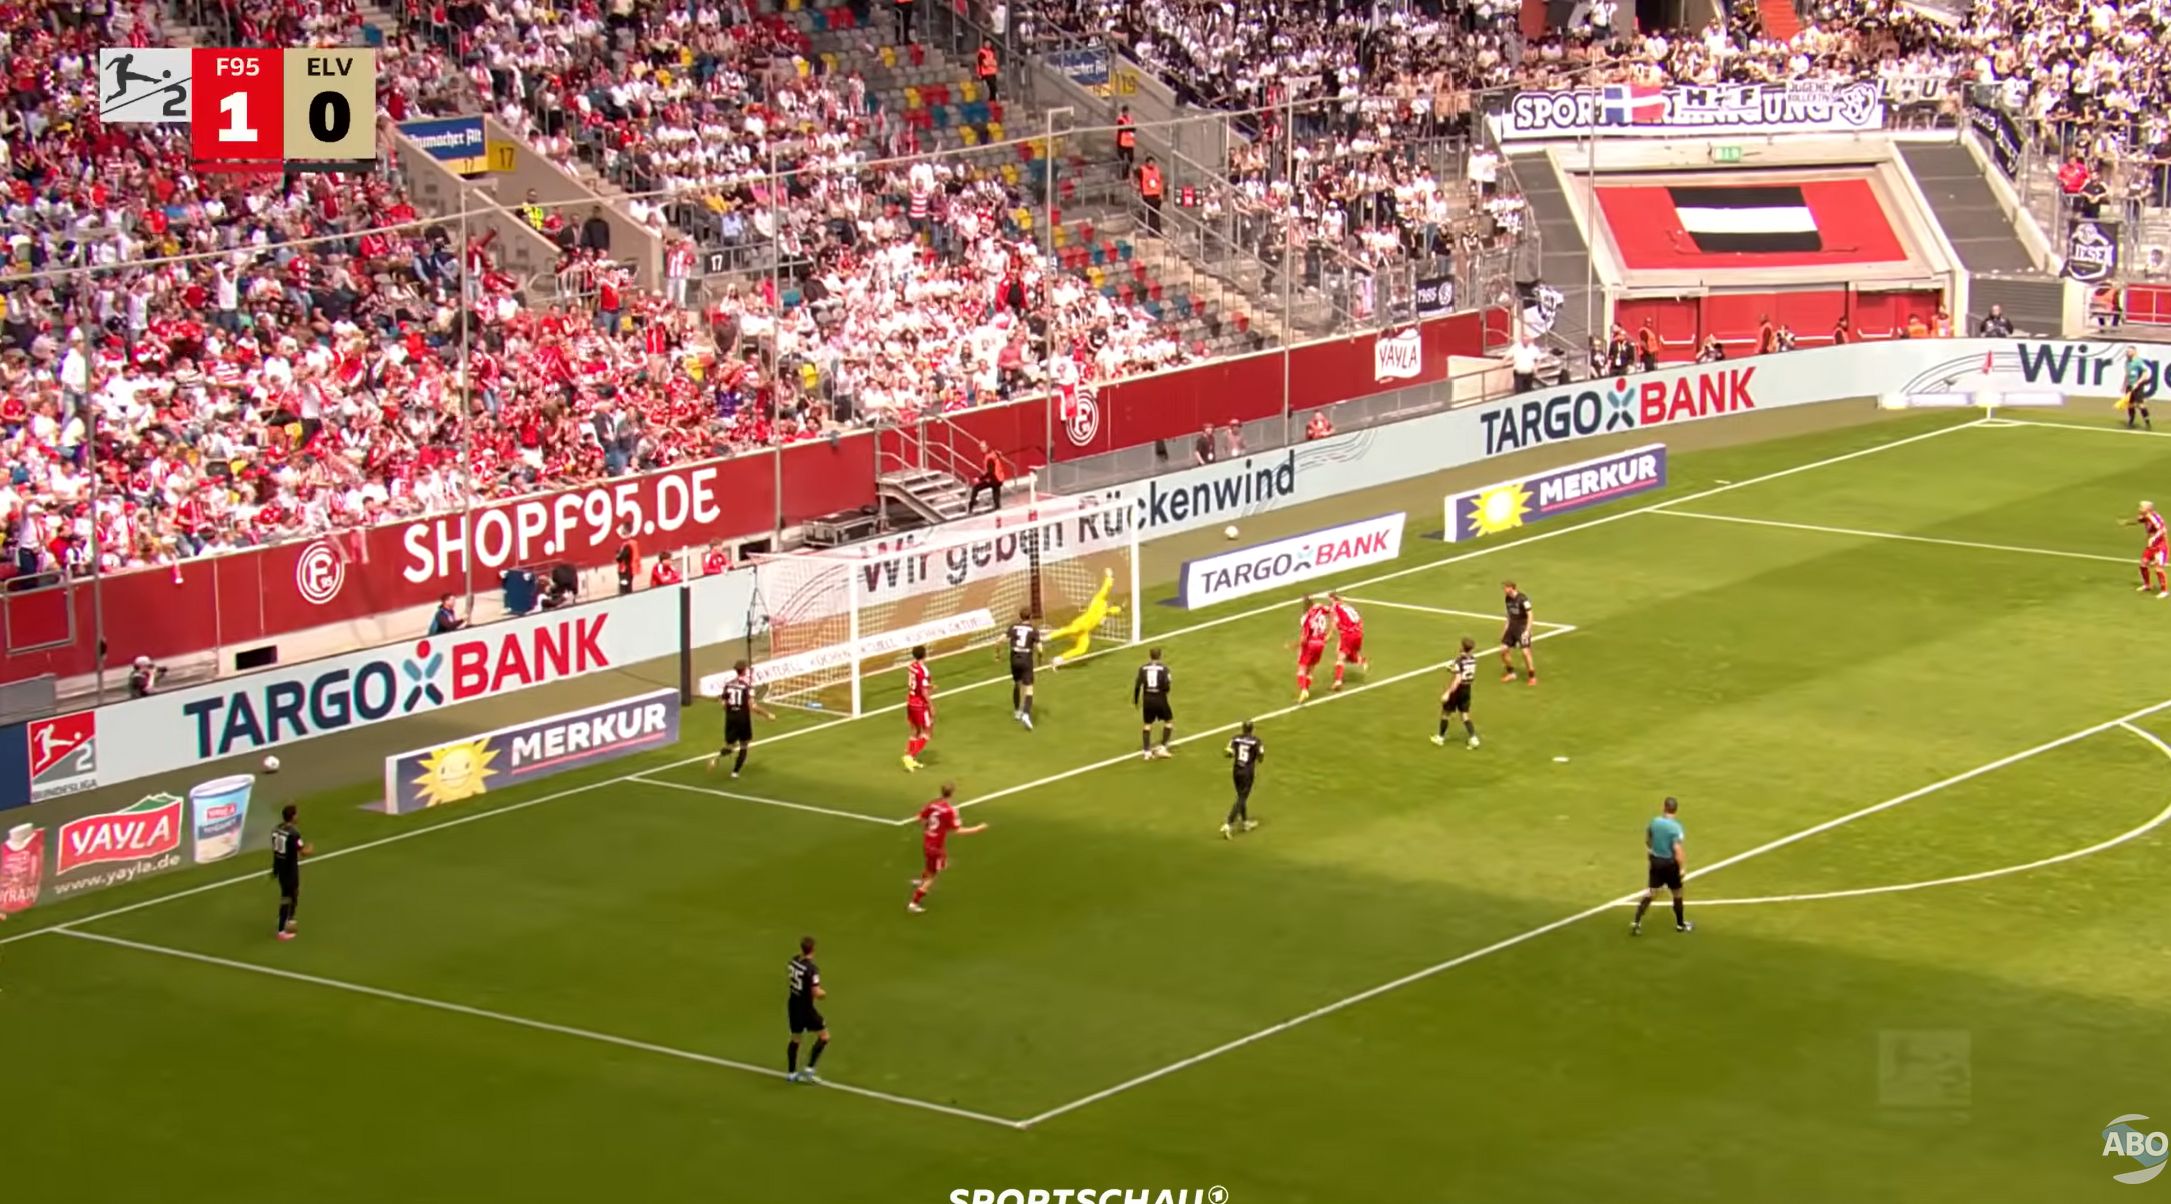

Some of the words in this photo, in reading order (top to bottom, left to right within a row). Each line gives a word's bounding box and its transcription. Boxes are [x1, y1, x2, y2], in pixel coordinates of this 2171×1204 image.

[499, 147, 514, 169] 17
[711, 254, 723, 272] 17
[1379, 343, 1417, 369] YAYLA
[2017, 343, 2113, 386] Wir
[1539, 454, 1658, 507] MERKUR
[511, 702, 667, 768] MERKUR
[75, 743, 94, 773] 2
[70, 815, 171, 857] YAYLA
[54, 853, 181, 895] www.yayla.de
